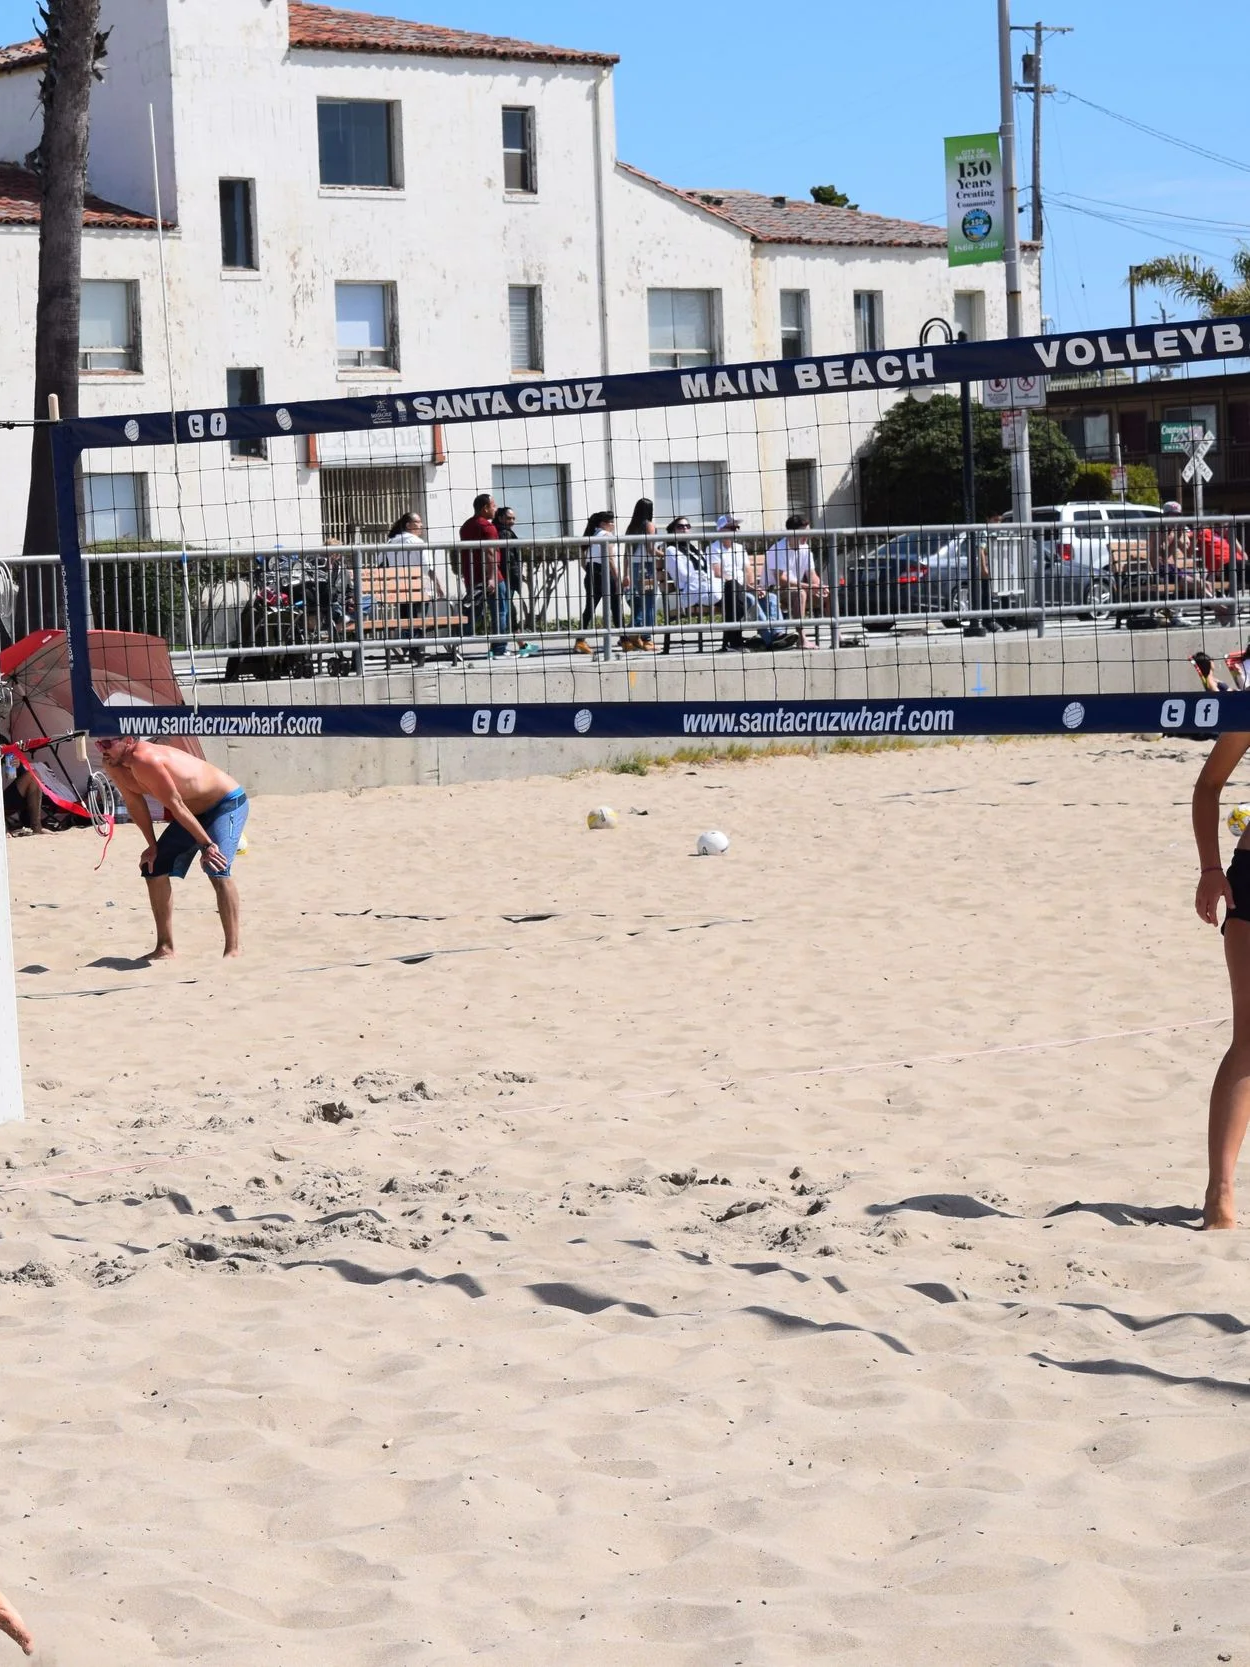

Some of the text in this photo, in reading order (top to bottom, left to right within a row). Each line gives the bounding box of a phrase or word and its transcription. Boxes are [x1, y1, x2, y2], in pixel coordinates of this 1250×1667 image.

[958, 160, 992, 178] 150
[955, 189, 995, 199] Creating
[956, 179, 992, 190] Years
[1033, 323, 1250, 368] VOLLEYB
[679, 352, 936, 399] MAIN BEACH
[412, 390, 513, 421] SANTA
[517, 382, 607, 413] CRUZ
[119, 711, 323, 735] www.santacruzwharf.com
[682, 704, 954, 733] www.santacruzwharf.com
